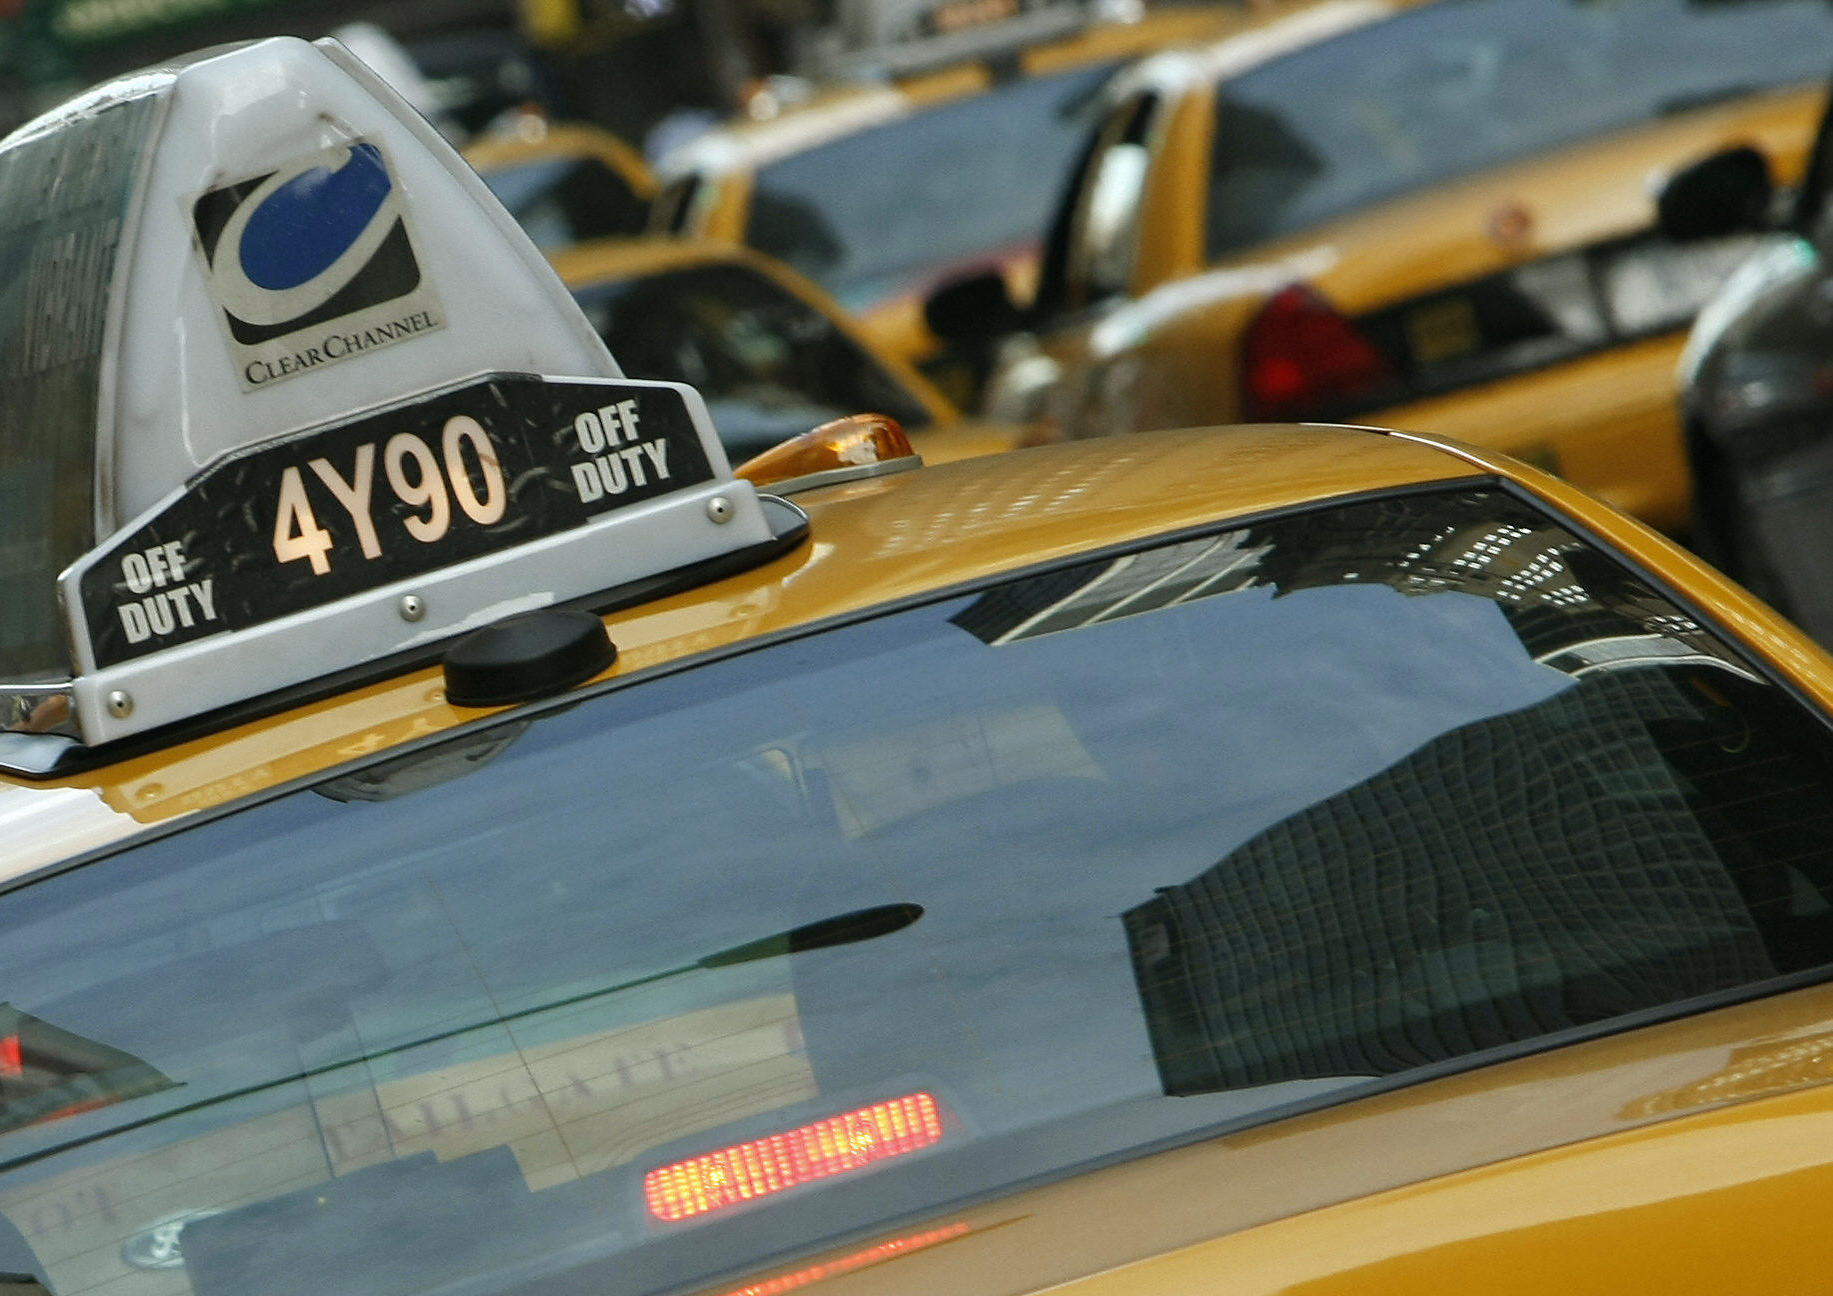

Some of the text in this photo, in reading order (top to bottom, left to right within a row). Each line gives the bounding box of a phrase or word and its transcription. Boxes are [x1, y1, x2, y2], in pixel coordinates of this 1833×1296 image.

[574, 399, 640, 455] OFF
[272, 415, 507, 577] 4Y90
[570, 437, 671, 504] DUTY
[120, 540, 187, 595] OFF
[117, 579, 217, 645] DUTY
